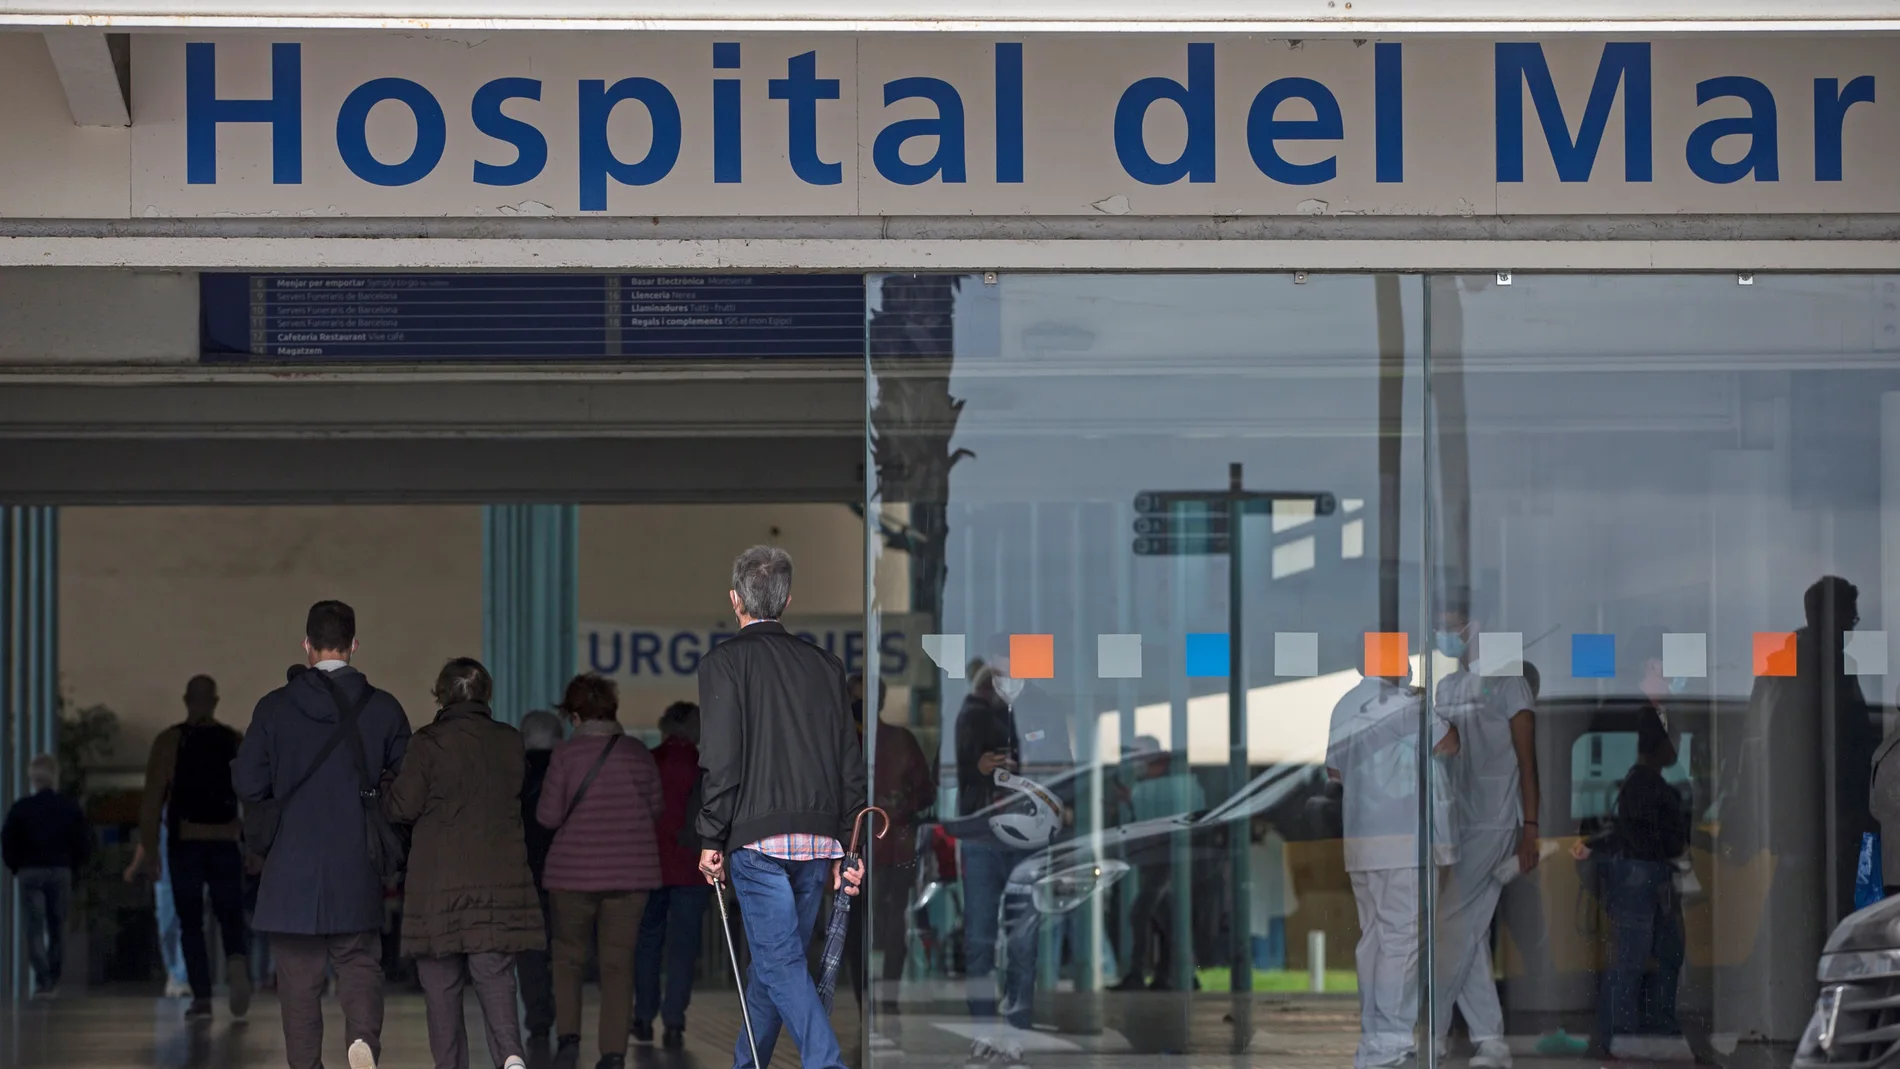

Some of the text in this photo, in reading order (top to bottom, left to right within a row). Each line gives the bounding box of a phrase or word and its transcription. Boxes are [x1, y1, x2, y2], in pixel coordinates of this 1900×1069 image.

[186, 42, 1876, 211] Hospital del Mar
[276, 279, 307, 288] Menjar
[308, 280, 323, 288] per
[325, 279, 365, 288] emportar
[631, 277, 655, 286] Basar
[707, 277, 753, 285] Montserrat
[276, 292, 305, 301] Serveis
[306, 292, 345, 301] Funeraris
[345, 292, 356, 300] de
[357, 292, 398, 300] Barcelona
[671, 291, 696, 300] Nerea
[276, 306, 305, 315] Serveis
[345, 306, 356, 314] de
[357, 306, 398, 314] Barcelona
[631, 304, 689, 313] Llaminadures
[276, 319, 305, 328] Serveis
[345, 319, 356, 327] de
[357, 319, 398, 327] Barcelona
[631, 318, 660, 327] Regals
[666, 317, 724, 326] complements
[319, 333, 367, 341] Restaurant
[277, 346, 323, 356] Magatzem
[588, 622, 908, 675] URGIES
